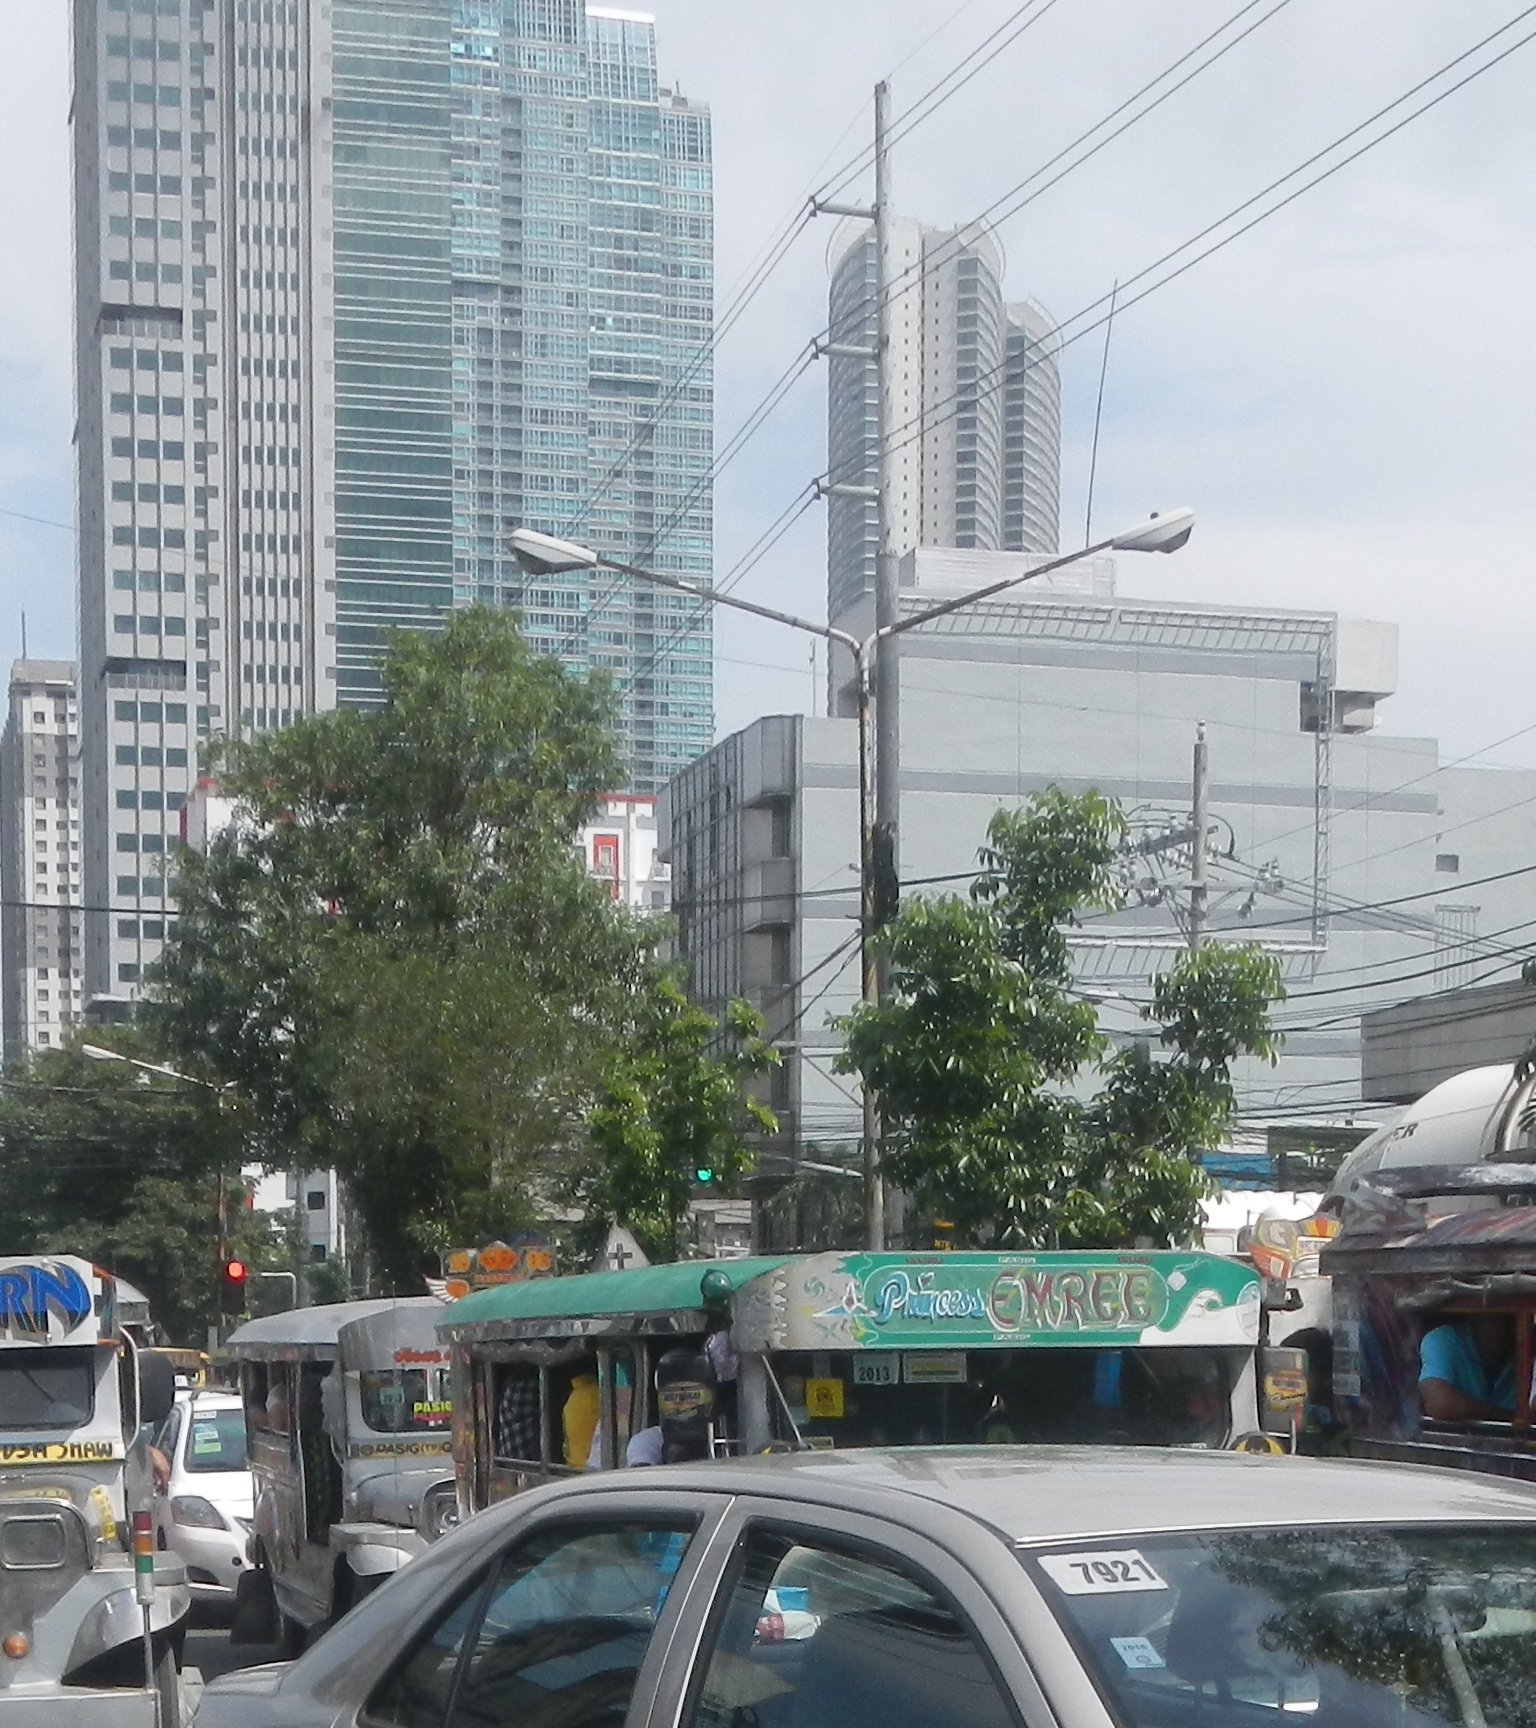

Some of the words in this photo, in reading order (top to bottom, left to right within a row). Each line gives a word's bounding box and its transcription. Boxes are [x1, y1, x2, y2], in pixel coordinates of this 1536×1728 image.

[873, 1268, 987, 1327] Princess
[858, 1366, 891, 1382] 2013
[1068, 1559, 1157, 1585] 7921
